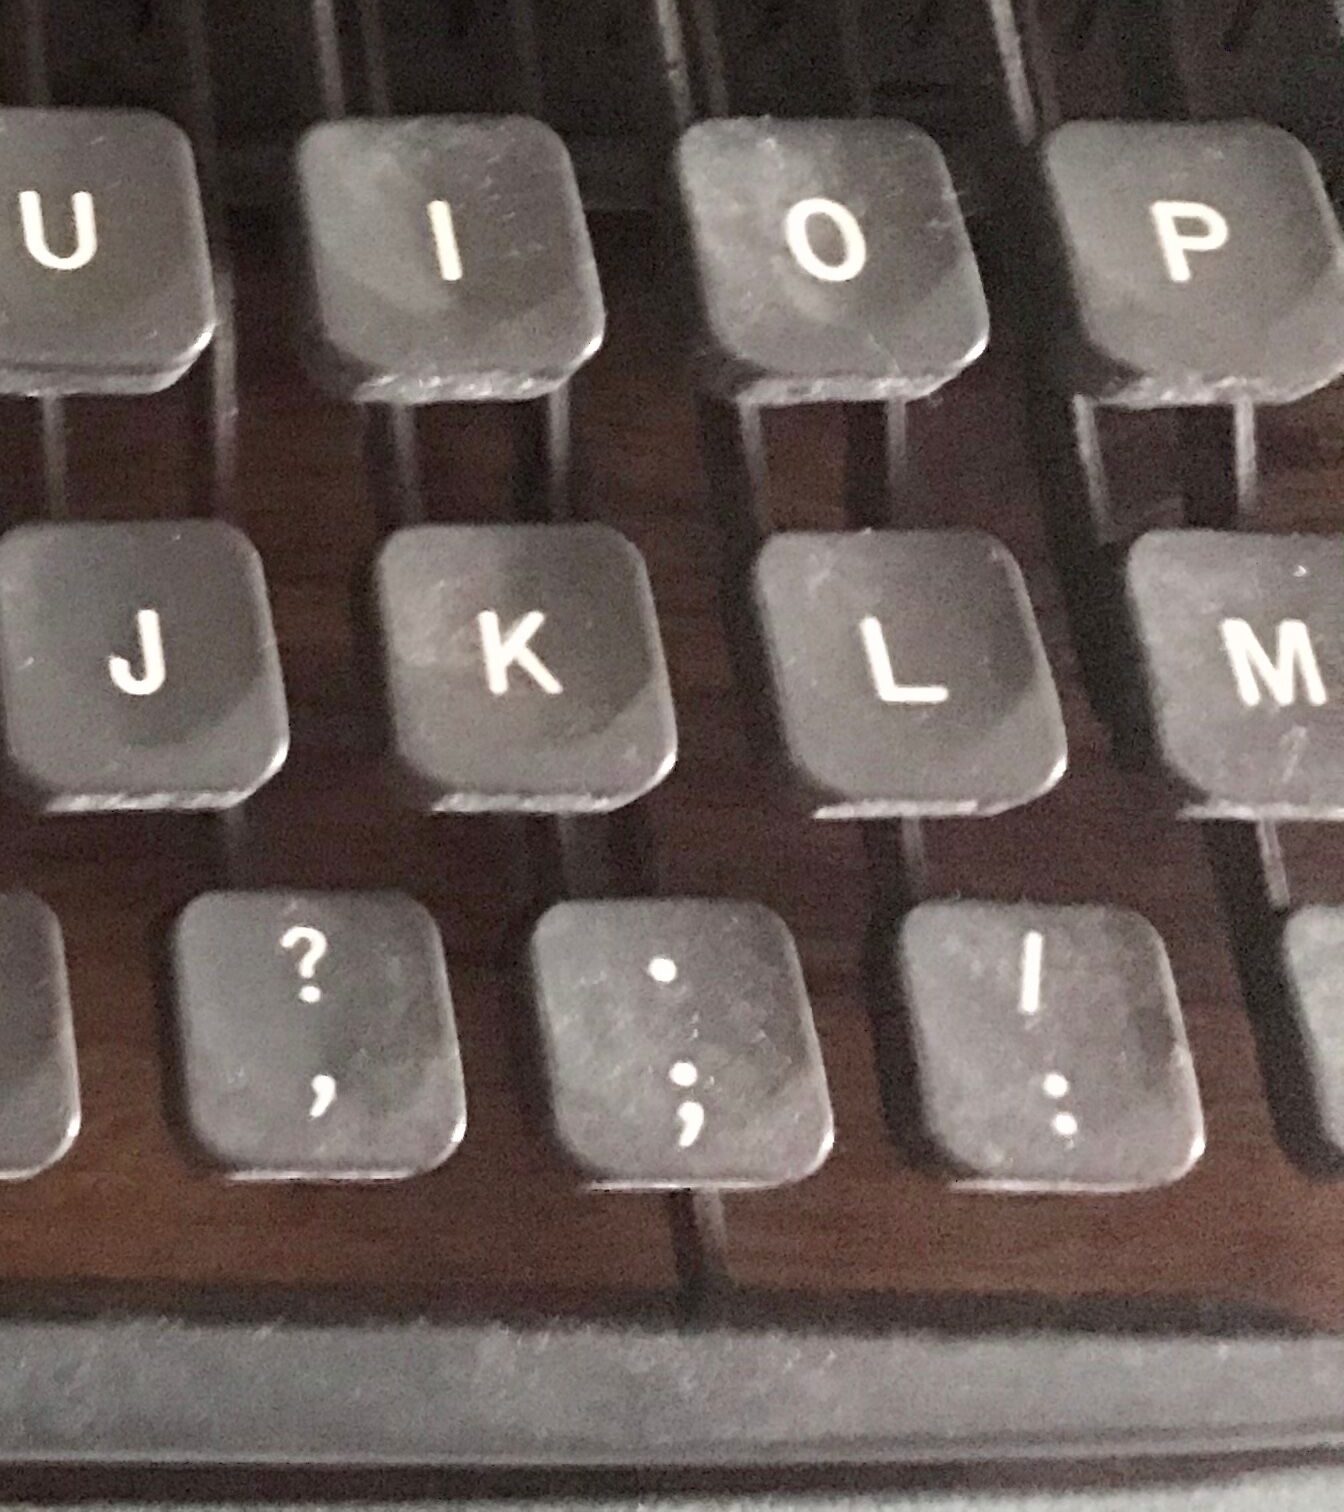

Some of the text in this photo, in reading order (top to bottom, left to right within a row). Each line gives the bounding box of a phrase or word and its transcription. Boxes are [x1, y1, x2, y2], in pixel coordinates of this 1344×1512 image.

[18, 189, 98, 271] U
[427, 199, 463, 282] I
[783, 196, 867, 283] O
[1149, 200, 1229, 284] P
[107, 608, 167, 697] J
[476, 609, 563, 696] K
[858, 615, 950, 705] L
[1220, 617, 1328, 708] M
[279, 925, 328, 1004] ?
[668, 1061, 706, 1148] ;
[1042, 1072, 1079, 1137] :
